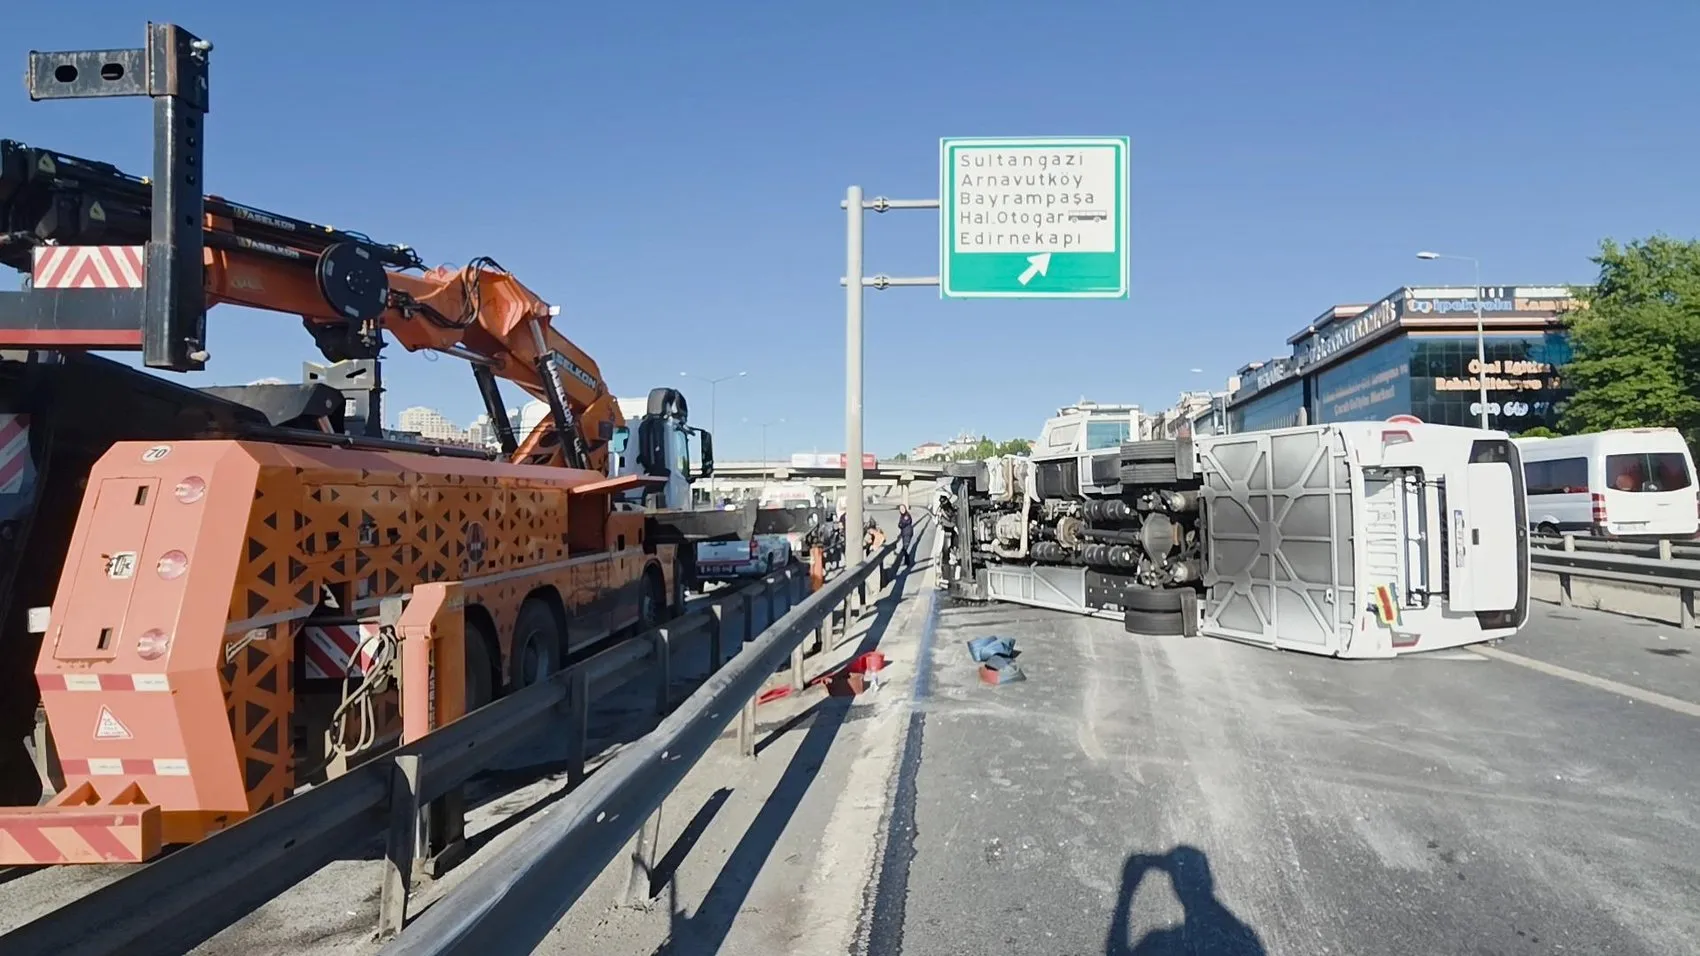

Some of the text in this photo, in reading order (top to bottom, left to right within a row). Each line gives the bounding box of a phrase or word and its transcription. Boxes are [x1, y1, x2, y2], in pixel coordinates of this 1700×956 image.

[960, 152, 1084, 171] Sultangazi
[961, 172, 1083, 188] Arnavutköy
[960, 192, 1095, 208] Bayrampaşa
[960, 231, 1082, 248] Edirnekapı
[146, 447, 168, 458] 70
